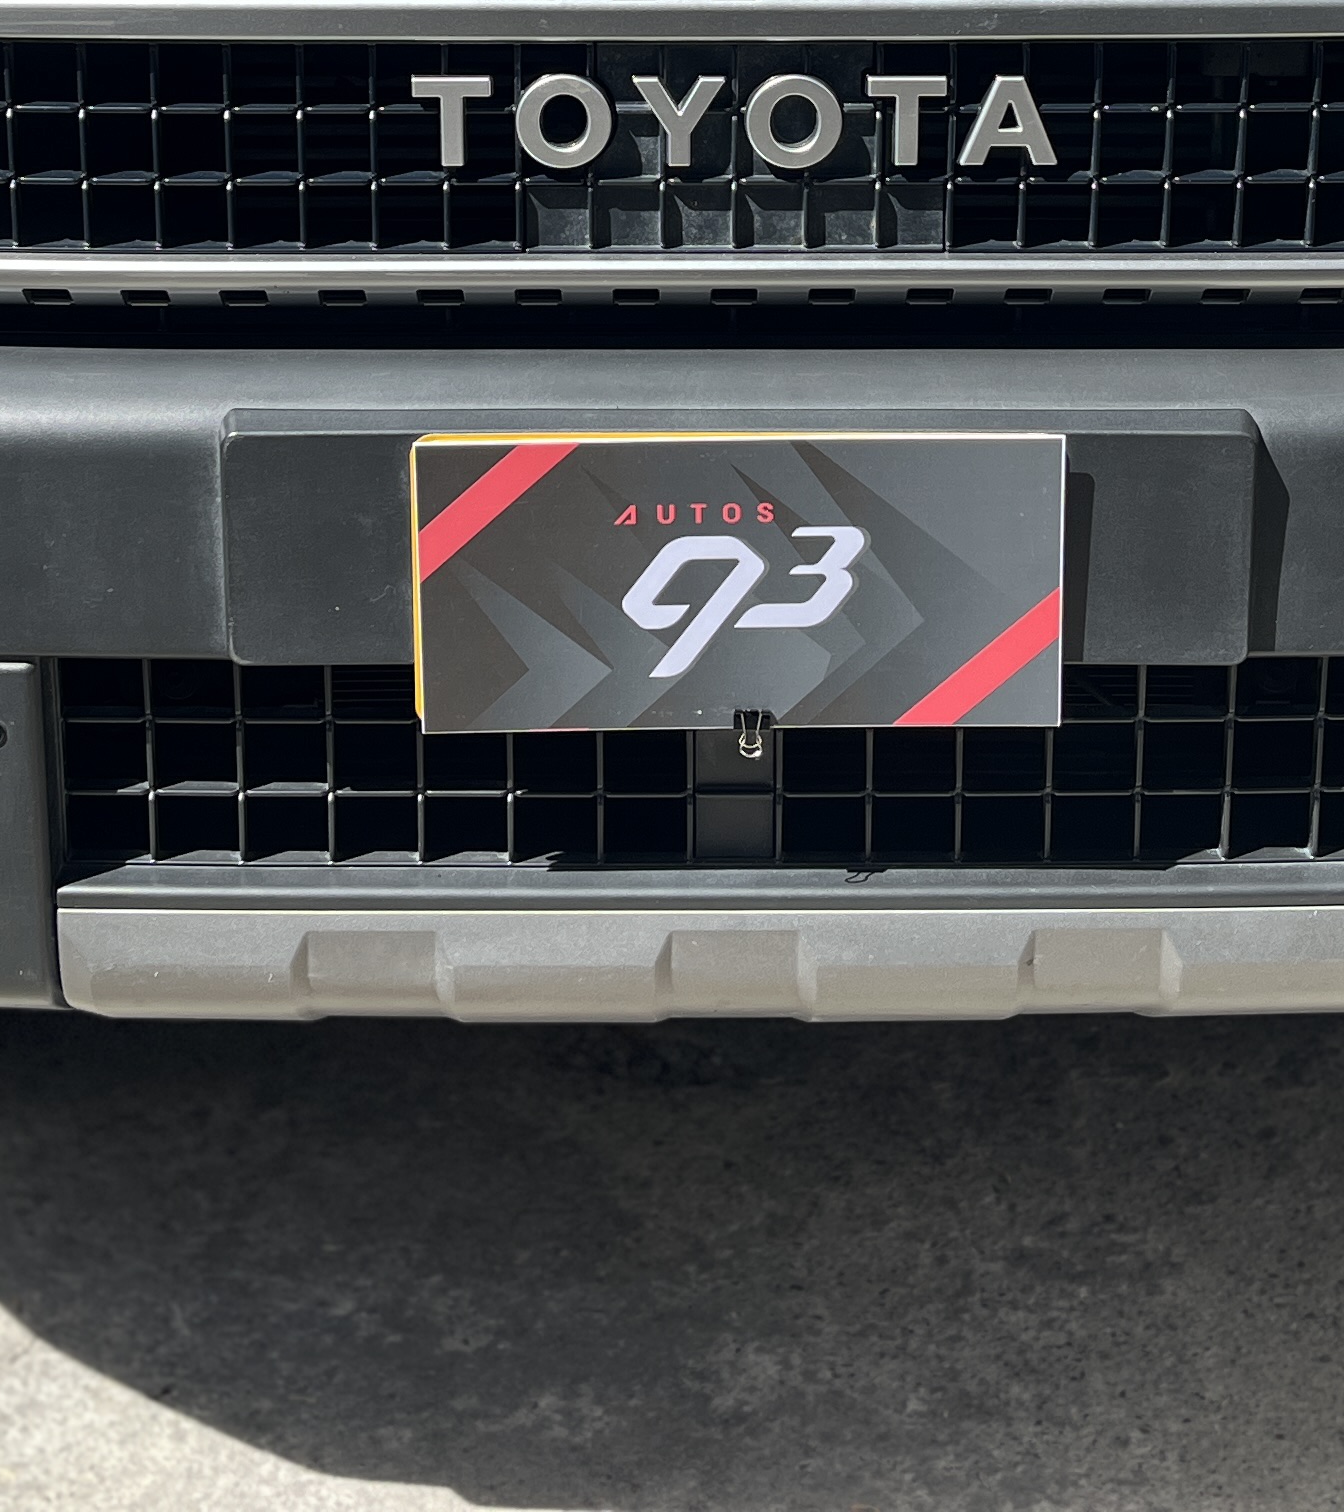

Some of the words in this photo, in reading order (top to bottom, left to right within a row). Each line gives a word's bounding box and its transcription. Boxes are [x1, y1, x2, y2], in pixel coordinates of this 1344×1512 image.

[411, 73, 1057, 169] TOYOTA
[613, 501, 776, 526] AUTOS
[620, 525, 866, 679] 93
